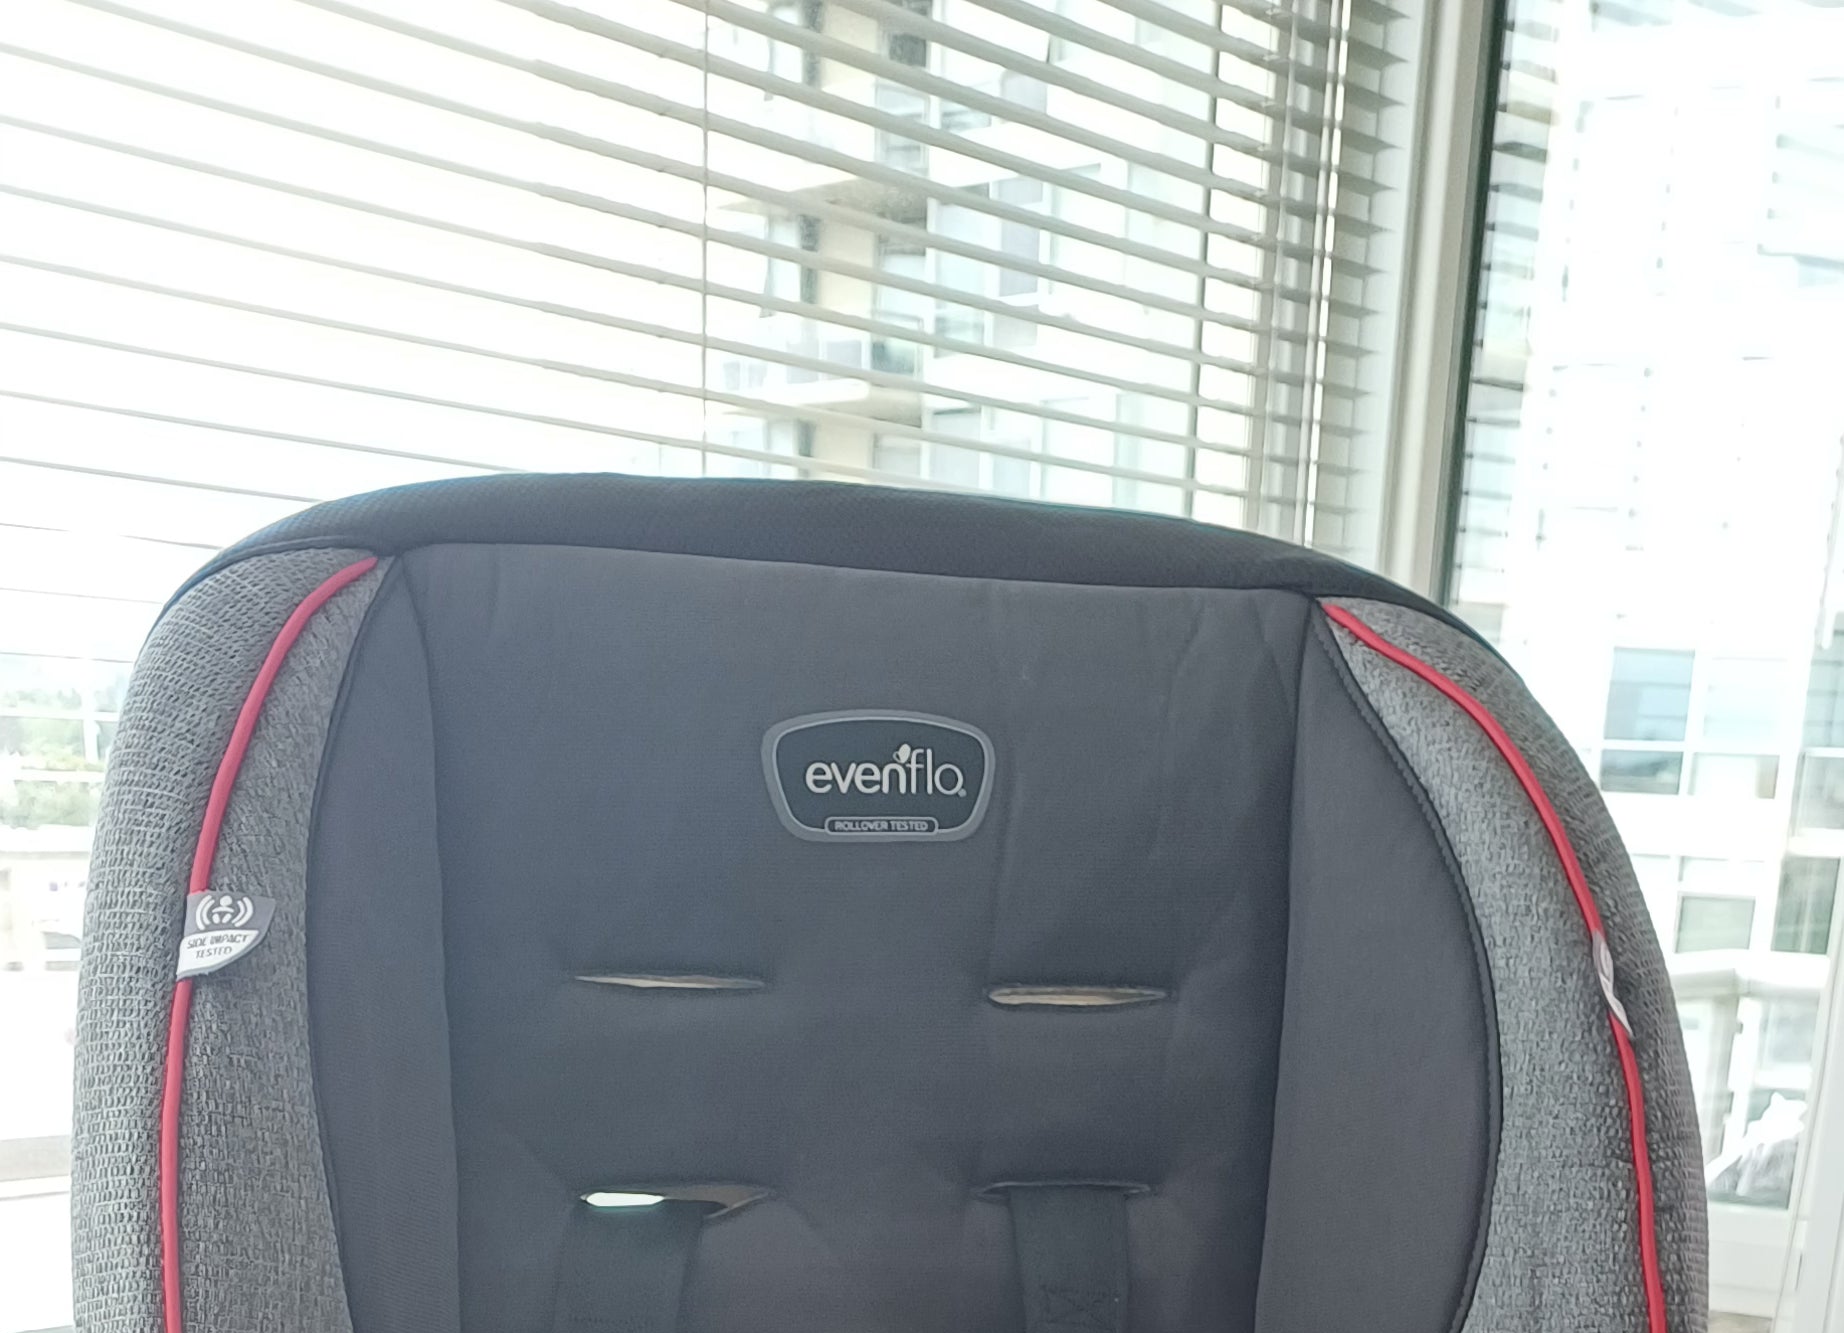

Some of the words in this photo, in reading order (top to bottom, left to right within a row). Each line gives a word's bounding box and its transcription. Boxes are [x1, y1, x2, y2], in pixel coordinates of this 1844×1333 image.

[805, 745, 964, 795] evenflo
[834, 820, 888, 831] ROLLOVER
[889, 820, 928, 831] TESTED
[187, 936, 207, 948] SIDE
[210, 934, 248, 944] IMPACT
[196, 946, 232, 958] TESTED
